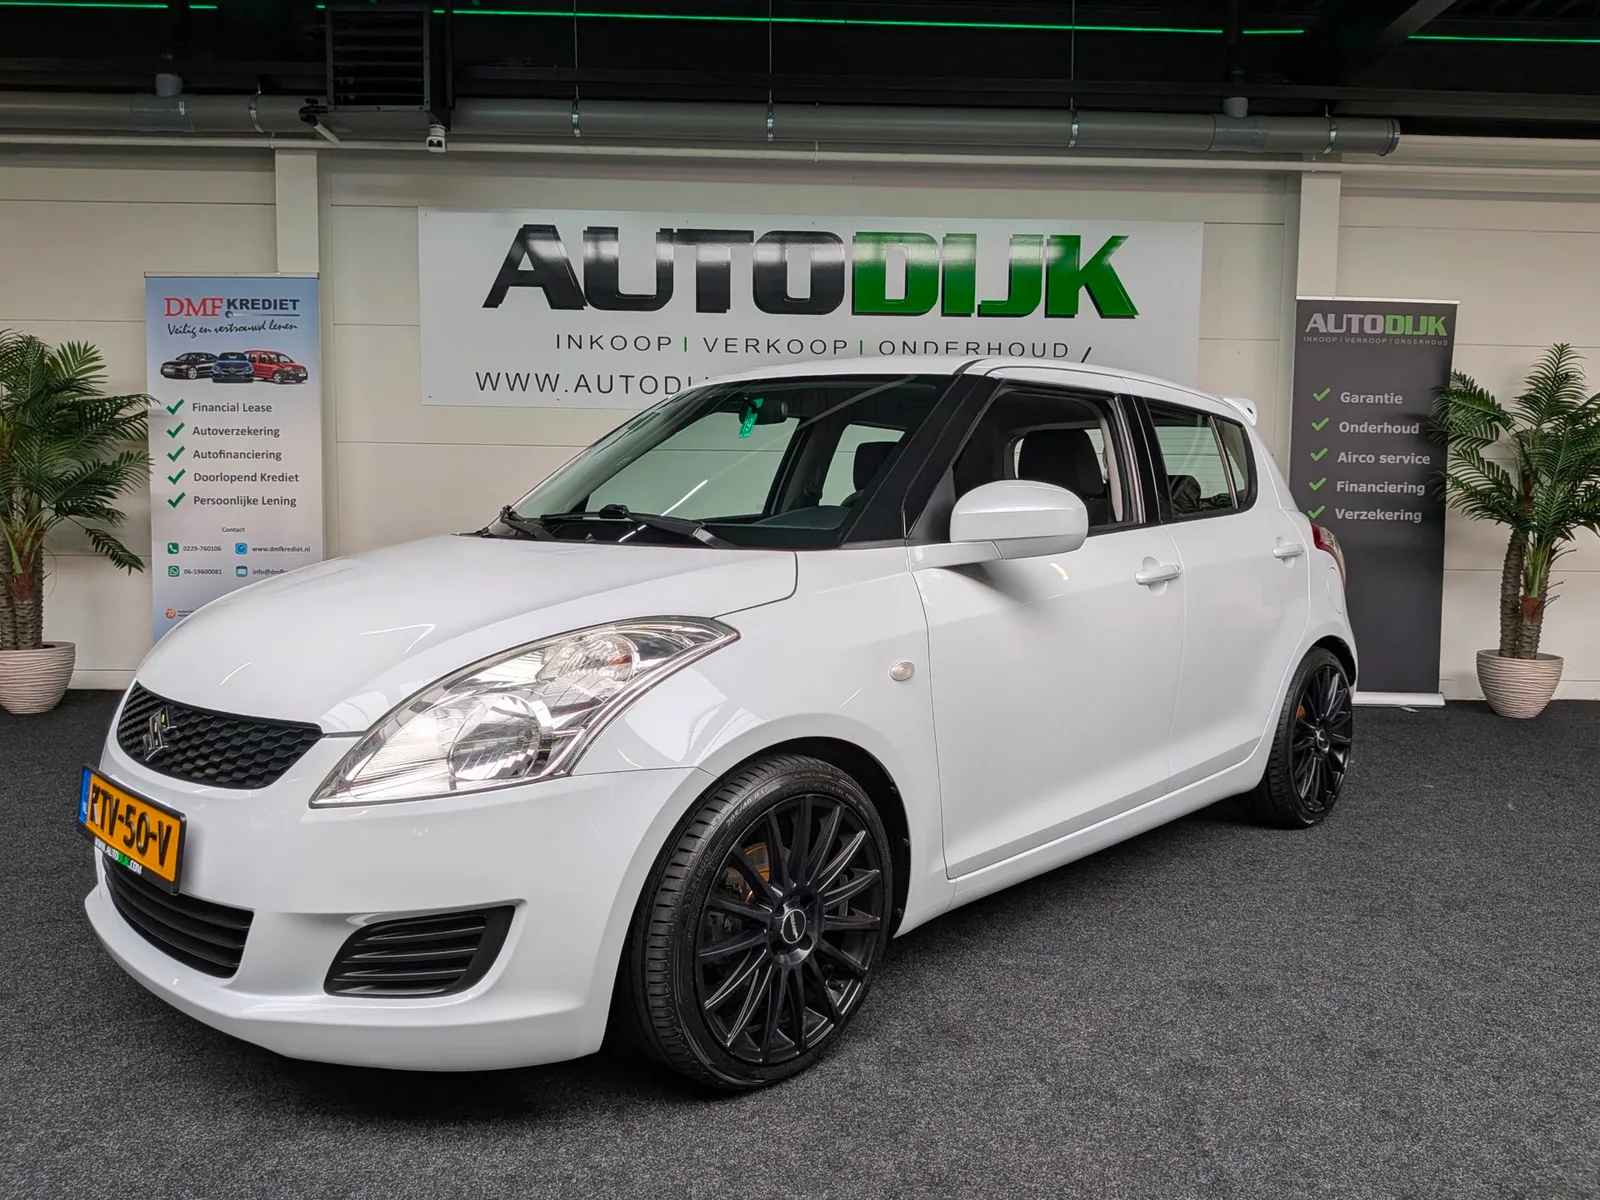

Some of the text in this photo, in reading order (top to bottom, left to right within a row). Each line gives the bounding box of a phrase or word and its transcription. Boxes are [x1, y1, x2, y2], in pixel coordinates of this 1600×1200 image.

[482, 224, 1139, 319] AUTODIJK
[163, 298, 300, 317] DMF KREDIET
[168, 323, 198, 339] Veilig
[214, 320, 267, 333] vertrouwd
[268, 319, 298, 330] lenen
[1305, 313, 1447, 336] AUTODIJK
[556, 334, 1068, 358] INKOOP VERKOOP ONDERHOUD
[1394, 338, 1448, 346] ONDERHOUD
[475, 371, 709, 395] WWW.AUTODI
[1340, 391, 1403, 404] Garantie
[192, 402, 272, 413] Financial Lease
[192, 426, 280, 438] Autoverzekering
[1339, 421, 1420, 434] Onderhoud
[192, 449, 282, 461] Autofinanciering
[1337, 452, 1431, 464] Airco service
[193, 472, 300, 484] Doorlopend Krediet
[1336, 481, 1426, 496] Financiering
[193, 495, 297, 507] Persoonlijke Lening
[1335, 508, 1422, 523] Verzekering
